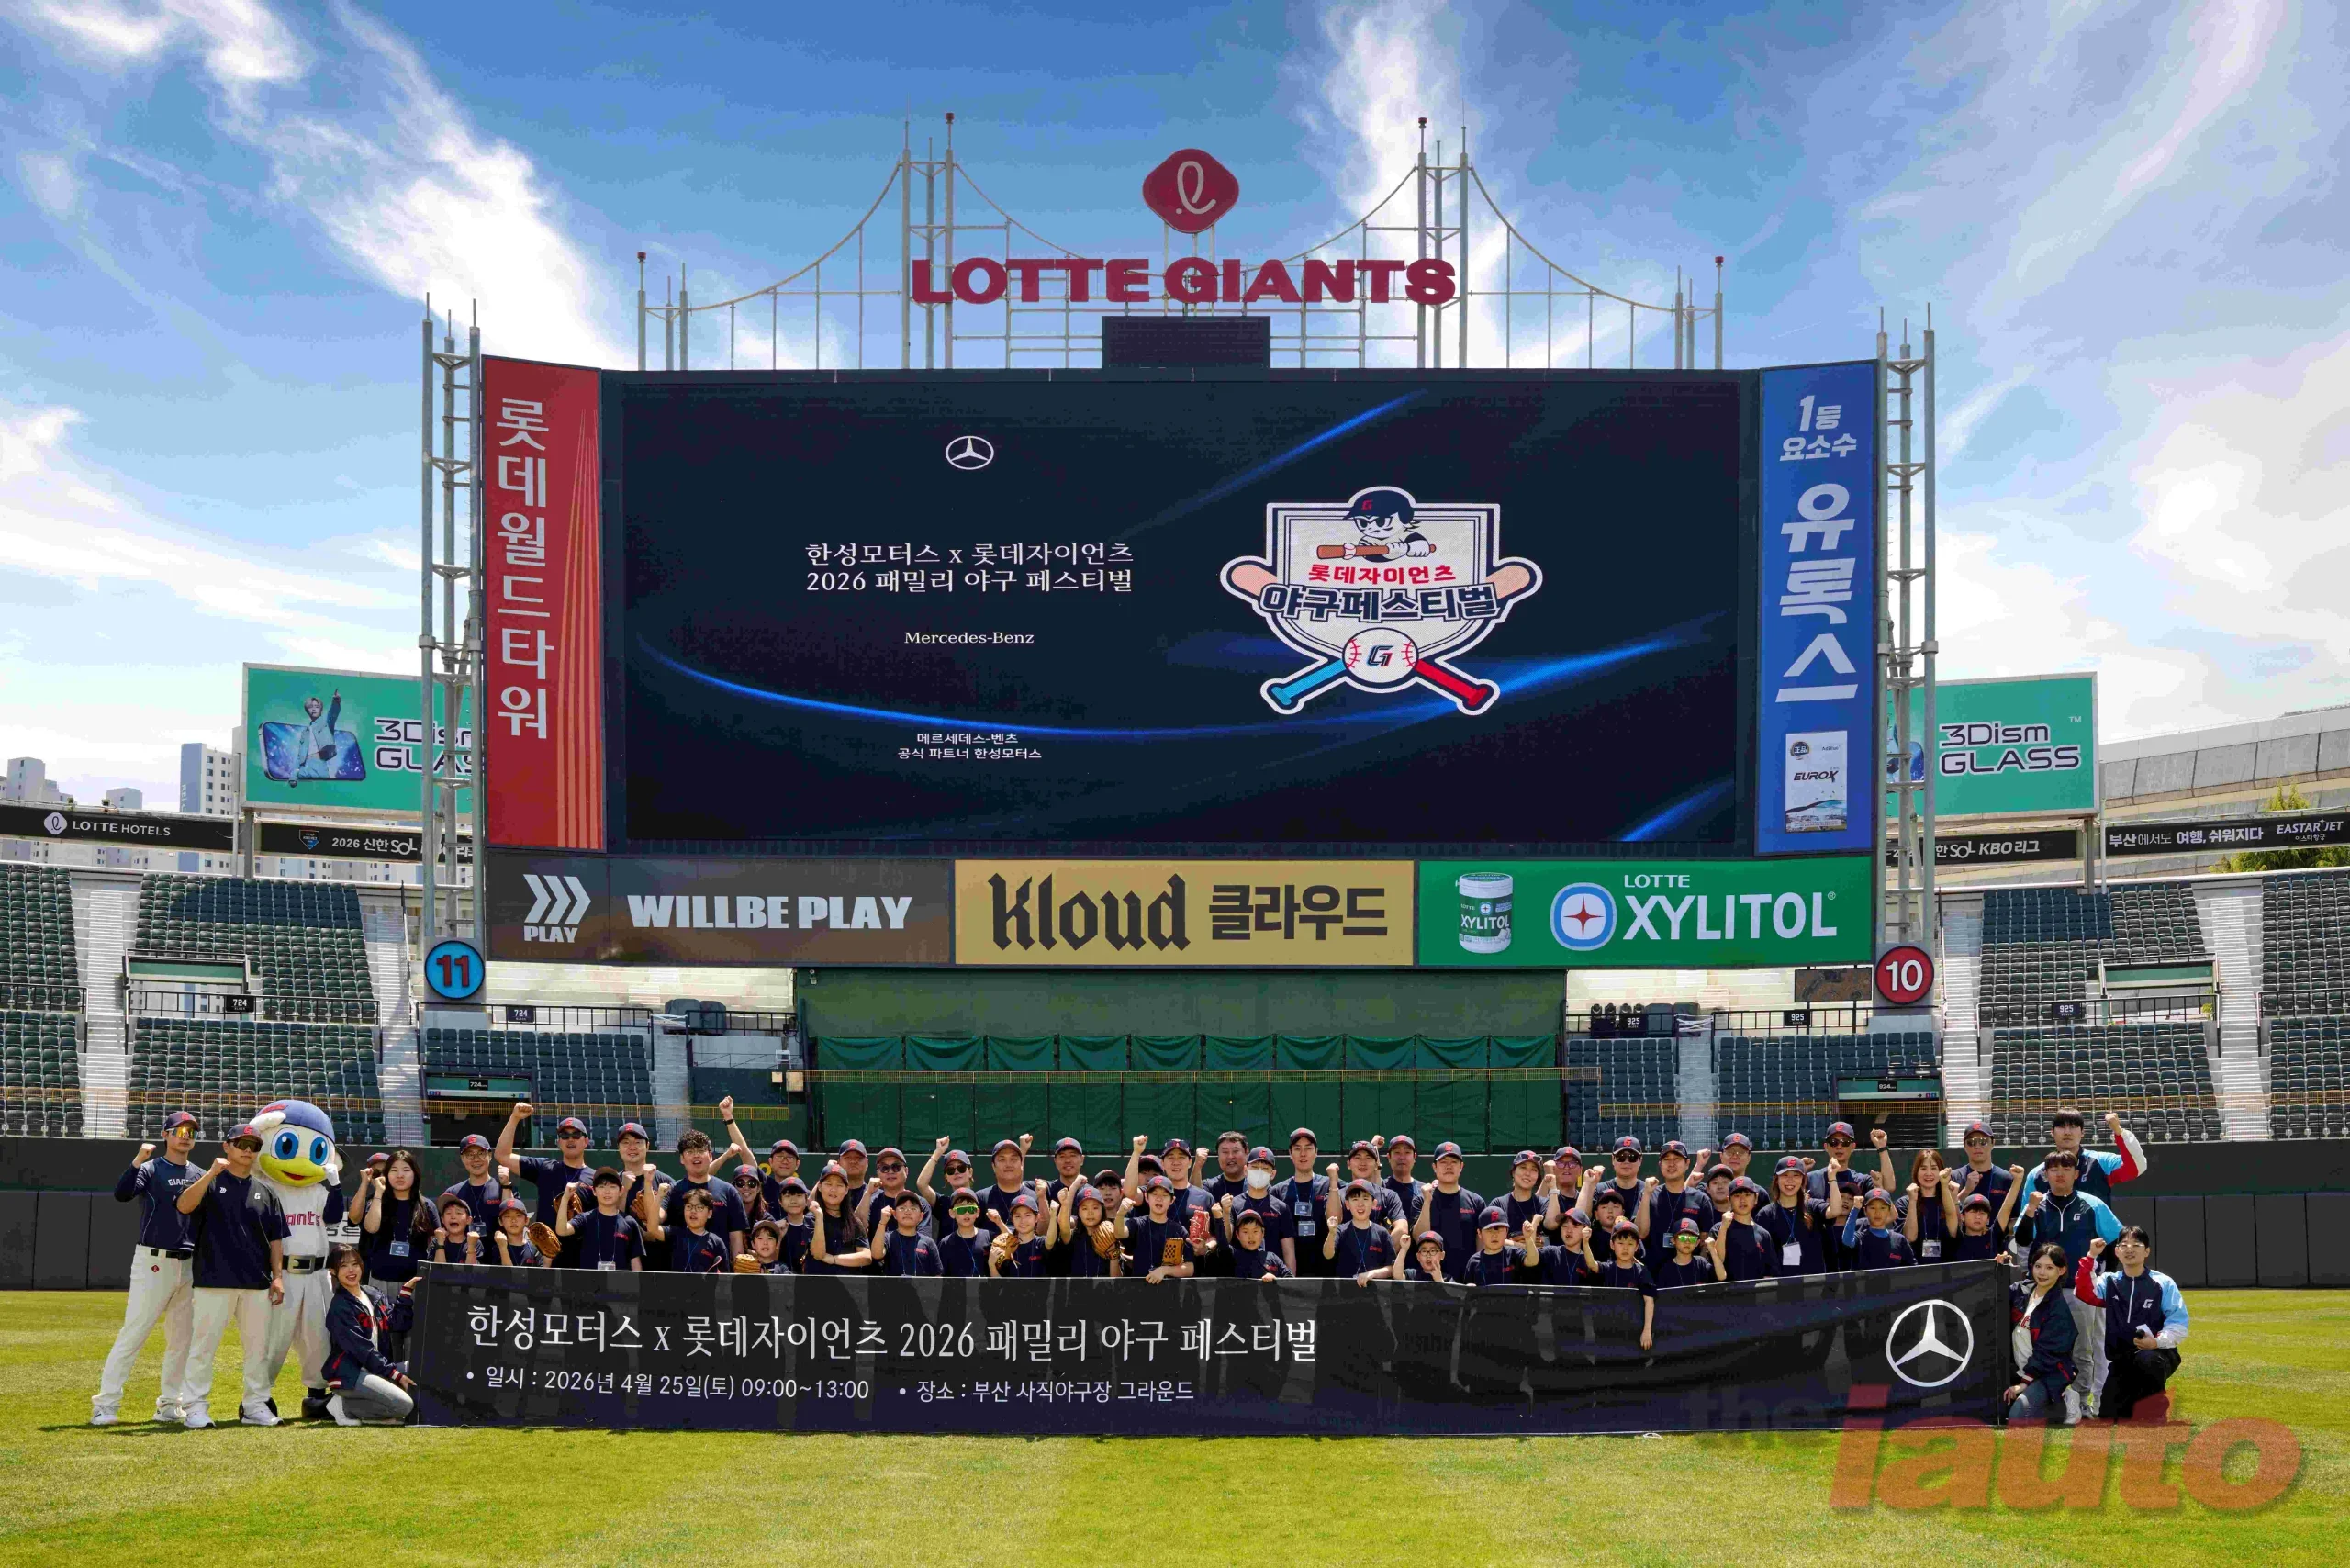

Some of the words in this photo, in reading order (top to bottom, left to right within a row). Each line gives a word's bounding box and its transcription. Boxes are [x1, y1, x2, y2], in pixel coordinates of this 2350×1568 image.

[912, 257, 1149, 304] LOTTE
[1164, 257, 1456, 305] GIANTS
[1799, 395, 1841, 431] 1등
[1779, 433, 1857, 461] 요소수
[805, 543, 940, 566] 한성모터스
[971, 542, 1134, 566] 롯데자이언츠
[497, 398, 554, 738] 롯데월드타워
[1308, 564, 1456, 585] 롯데자이언츠
[806, 571, 866, 591] 2026
[875, 569, 953, 593] 패밀리
[964, 569, 1017, 592] 야구
[1025, 569, 1132, 593] 페스티벌
[1775, 483, 1858, 702] 유록스
[904, 632, 1035, 644] Mercedes-Benz
[917, 734, 1018, 745] 메르세데스-벤츠
[1941, 722, 2049, 746] 3Dism
[898, 747, 923, 759] 공식
[928, 747, 968, 759] 파트너
[974, 747, 1042, 759] 한성모터스
[1941, 746, 2079, 774] GLASS
[1793, 770, 1839, 783] EUROX
[72, 821, 118, 833] LOTTE
[121, 824, 171, 836] HOTELS
[2109, 833, 2172, 848] 부산에서도
[2209, 827, 2264, 843] 쉬워지다
[331, 837, 360, 848] 2026
[364, 838, 389, 853] 신한
[1949, 840, 1976, 858] SOL
[1624, 874, 1690, 889] LOTTE
[627, 895, 789, 929] WILLBE
[798, 896, 912, 929] PLAY
[987, 872, 1191, 951] Kloud
[1209, 884, 1388, 941] 클라우드
[1460, 914, 1509, 929] XYLITOL
[523, 925, 578, 943] PLAY
[436, 955, 470, 988] 11
[1886, 959, 1923, 991] 10
[232, 998, 247, 1007] 724
[514, 1009, 528, 1017] 724
[2059, 1004, 2074, 1013] 925
[467, 1305, 643, 1353] 한성모터스
[653, 1326, 671, 1351] x
[681, 1316, 888, 1360] 롯데자이언츠
[900, 1321, 975, 1358] 2026
[986, 1318, 1086, 1361] 패밀리
[1101, 1318, 1169, 1361] 야구
[1180, 1318, 1316, 1362] 페스티벌
[487, 1367, 524, 1388] 일시
[545, 1371, 614, 1394] 2026년
[621, 1372, 652, 1396] 4월
[659, 1374, 735, 1399] 25일(토)
[741, 1377, 869, 1400] 09:00~13:00
[917, 1381, 955, 1403] 장소
[972, 1381, 1011, 1403] 부산
[1016, 1381, 1112, 1404] 사직야구장
[1118, 1381, 1194, 1403] 그라운드
